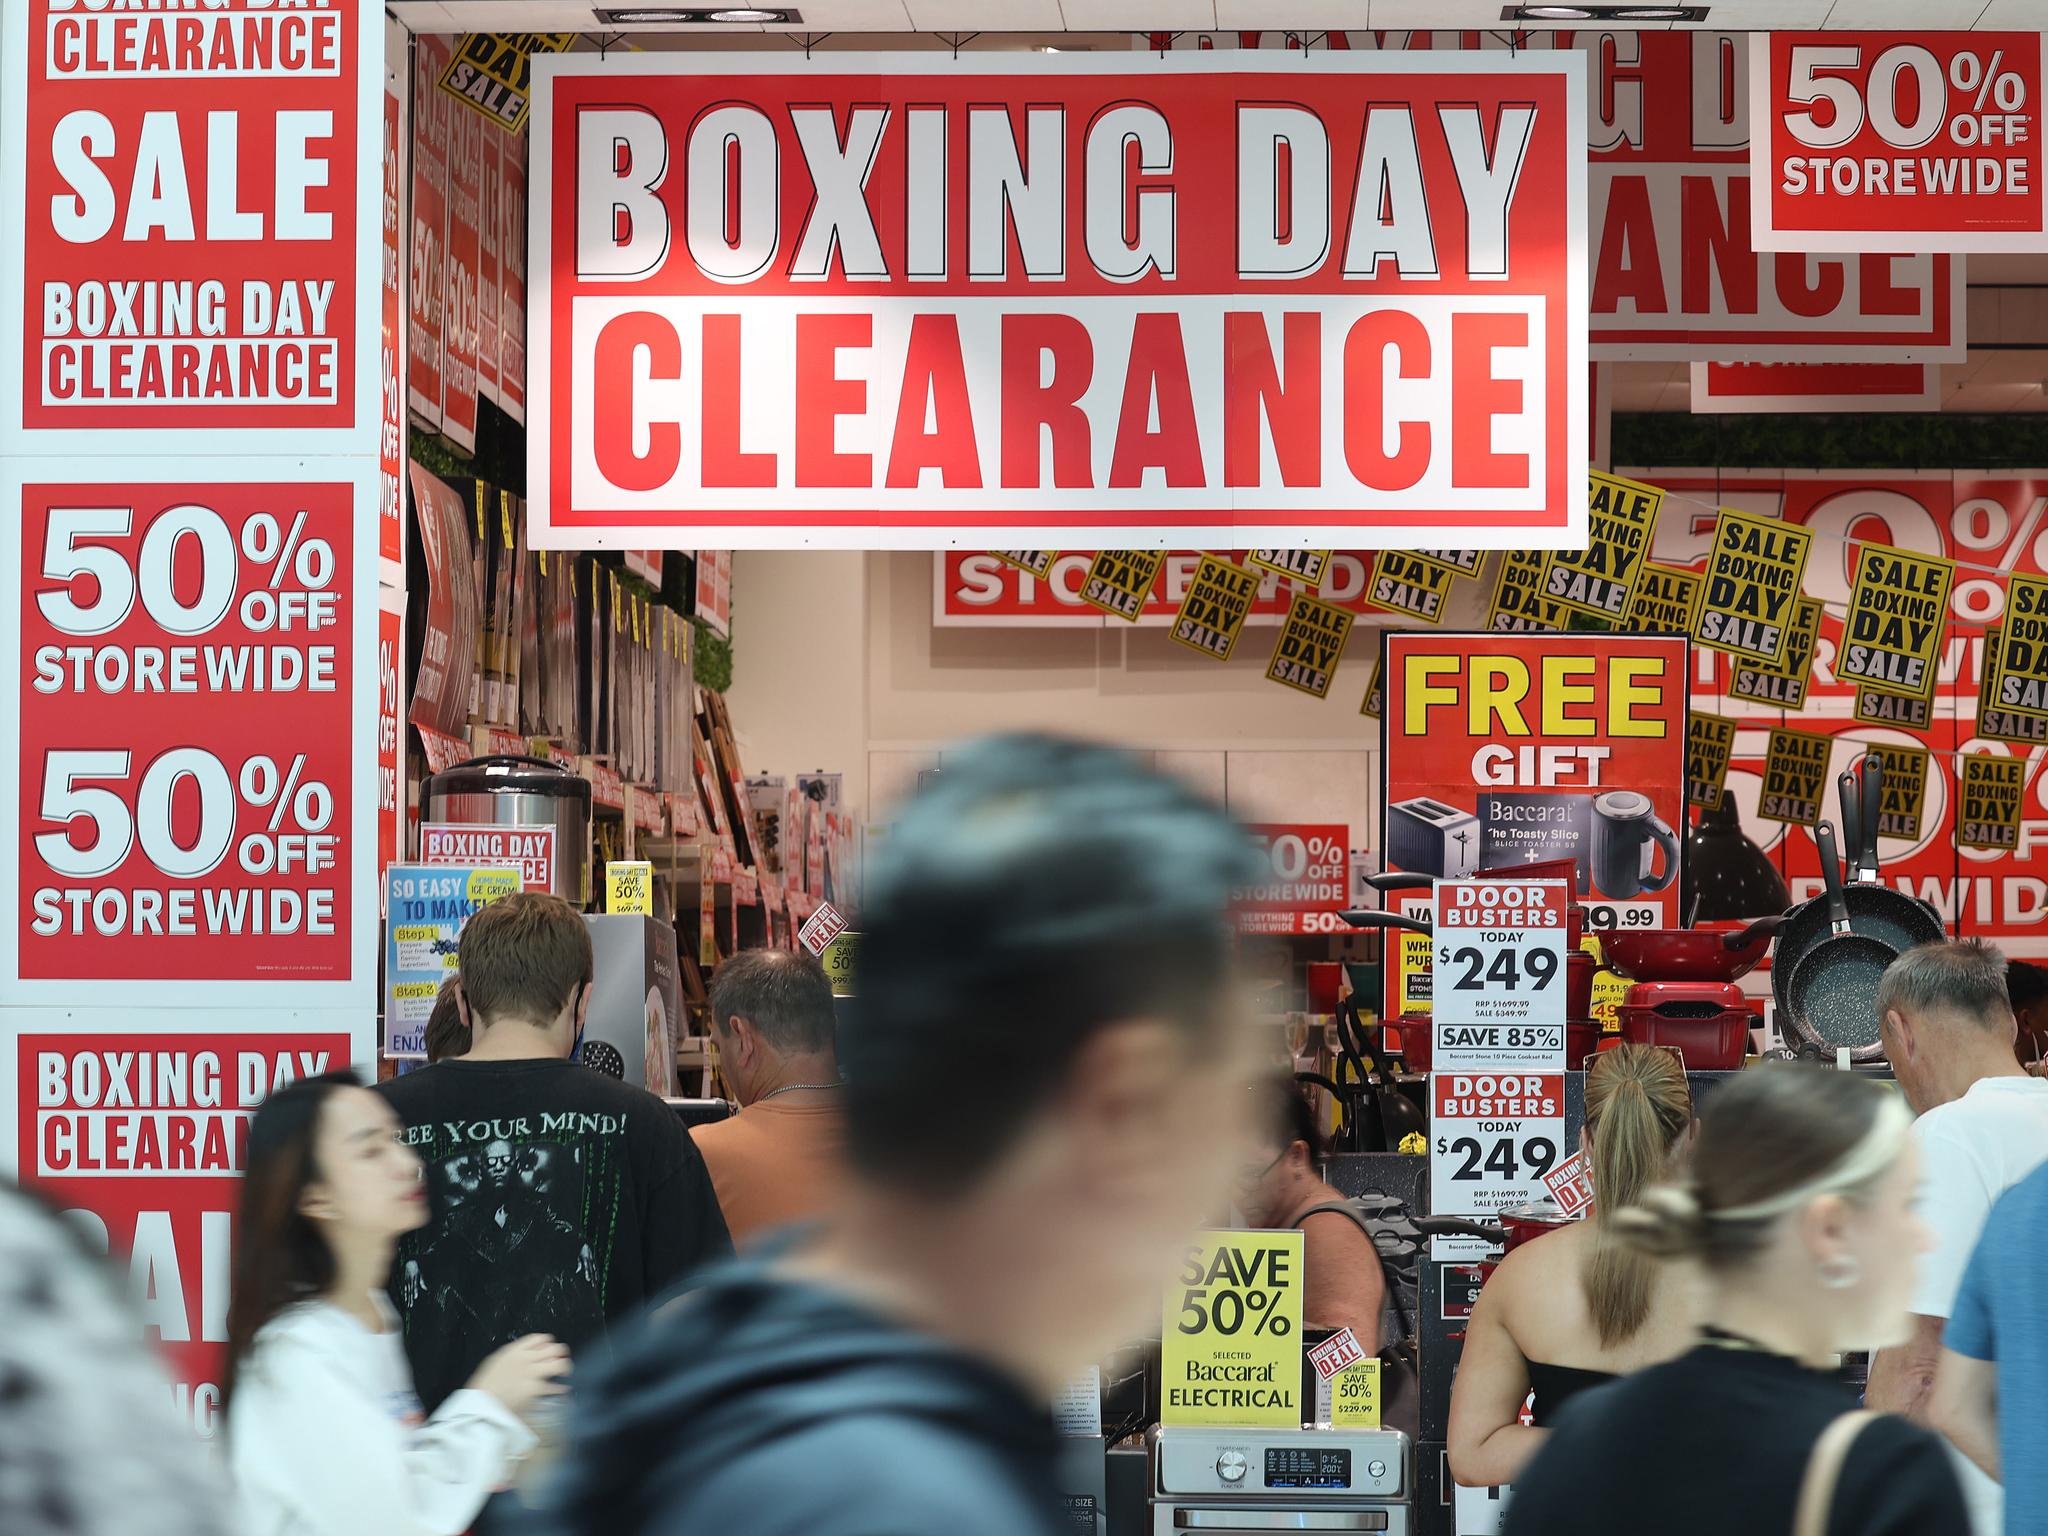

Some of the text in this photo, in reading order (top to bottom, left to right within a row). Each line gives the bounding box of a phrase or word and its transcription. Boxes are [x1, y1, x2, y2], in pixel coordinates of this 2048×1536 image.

[53, 17, 336, 72] CLEARANCE
[449, 61, 527, 123] SALE
[1781, 42, 2028, 150] 50%
[50, 109, 334, 244] SALE
[1781, 156, 2030, 196] STOREWIDE
[575, 100, 1177, 285] BOXING
[1235, 100, 1539, 282] DAY
[43, 280, 336, 337] BOXING DAY
[48, 344, 333, 399] CLEARANCE
[593, 309, 1530, 493] CLEARANCE
[1722, 522, 1801, 565] SALE
[34, 502, 337, 637] 50%
[1095, 556, 1150, 593] DAY
[1201, 562, 1253, 598] SALE
[1382, 552, 1446, 590] DAY
[1715, 552, 1794, 592] BOXING
[1865, 556, 1943, 597] SALE
[1086, 578, 1140, 615] SALE
[1193, 582, 1246, 614] BOXING
[1375, 577, 1441, 617] SALE
[1547, 566, 1628, 614] SALE
[1707, 575, 1790, 622] DAY
[1858, 586, 1937, 623] BOXING
[1186, 597, 1240, 634] DAY
[1294, 601, 1347, 634] SALE
[1851, 609, 1934, 654] DAY
[1178, 617, 1230, 655] SALE
[1287, 620, 1341, 650] BOXING
[1700, 610, 1781, 656] SALE
[32, 644, 337, 693] STOREWIDE
[1279, 636, 1335, 671] DAY
[1846, 645, 1926, 687] SALE
[1273, 658, 1328, 692] SALE
[1737, 671, 1802, 704] SALE
[1403, 654, 1667, 738] FREE
[1861, 693, 1927, 724] SALE
[1983, 711, 2047, 739] SALE
[1773, 735, 1826, 761] SALE
[1471, 743, 1610, 787] GIFT
[1771, 757, 1823, 778] BOXING
[1968, 762, 2020, 784] SALE
[1767, 771, 1821, 799] DAY
[1967, 784, 2018, 801] BOXING
[32, 746, 335, 879] 50%
[1490, 800, 1574, 823] Baccarat
[1764, 796, 1817, 822] SALE
[1878, 814, 1917, 836] ALE
[1965, 800, 2017, 823] DAY
[428, 833, 548, 858] BOXING DAY
[1494, 840, 1519, 848] SLICE
[1510, 828, 1580, 841] Toasty Slice
[1964, 822, 2016, 846] SALE
[392, 878, 462, 899] SO EASY
[471, 884, 482, 895] ICE
[615, 885, 645, 899] 50%
[618, 876, 639, 886] SAVE
[1456, 886, 1547, 908] DOOR
[31, 887, 336, 936] STOREWIDE
[402, 900, 426, 920] TO
[1446, 908, 1558, 927] BUSTERS
[398, 930, 425, 941] Step
[808, 915, 845, 951] DEAL
[1479, 932, 1524, 943] TODAY
[396, 986, 424, 997] Step
[1443, 1027, 1559, 1047] SAVE 85%
[38, 1051, 222, 1108] BOXING
[1453, 1076, 1543, 1097] DOOR
[1444, 1098, 1556, 1116] BUSTERS
[443, 1112, 627, 1144] YOUR MIND!
[1477, 1121, 1522, 1133] TODAY
[1473, 1200, 1492, 1208] SALE
[1178, 1247, 1290, 1287] SAVE
[1178, 1289, 1291, 1336] 50%
[1335, 1331, 1351, 1346] DAY
[1212, 1352, 1252, 1360] SELECTED
[1318, 1343, 1359, 1375] DEAL
[1340, 1384, 1372, 1398] 50%
[1343, 1374, 1367, 1383] SAVE
[1169, 1389, 1294, 1408] ELECTRICAL
[1338, 1405, 1373, 1413] $229.99
[1075, 1498, 1093, 1507] SIZE
